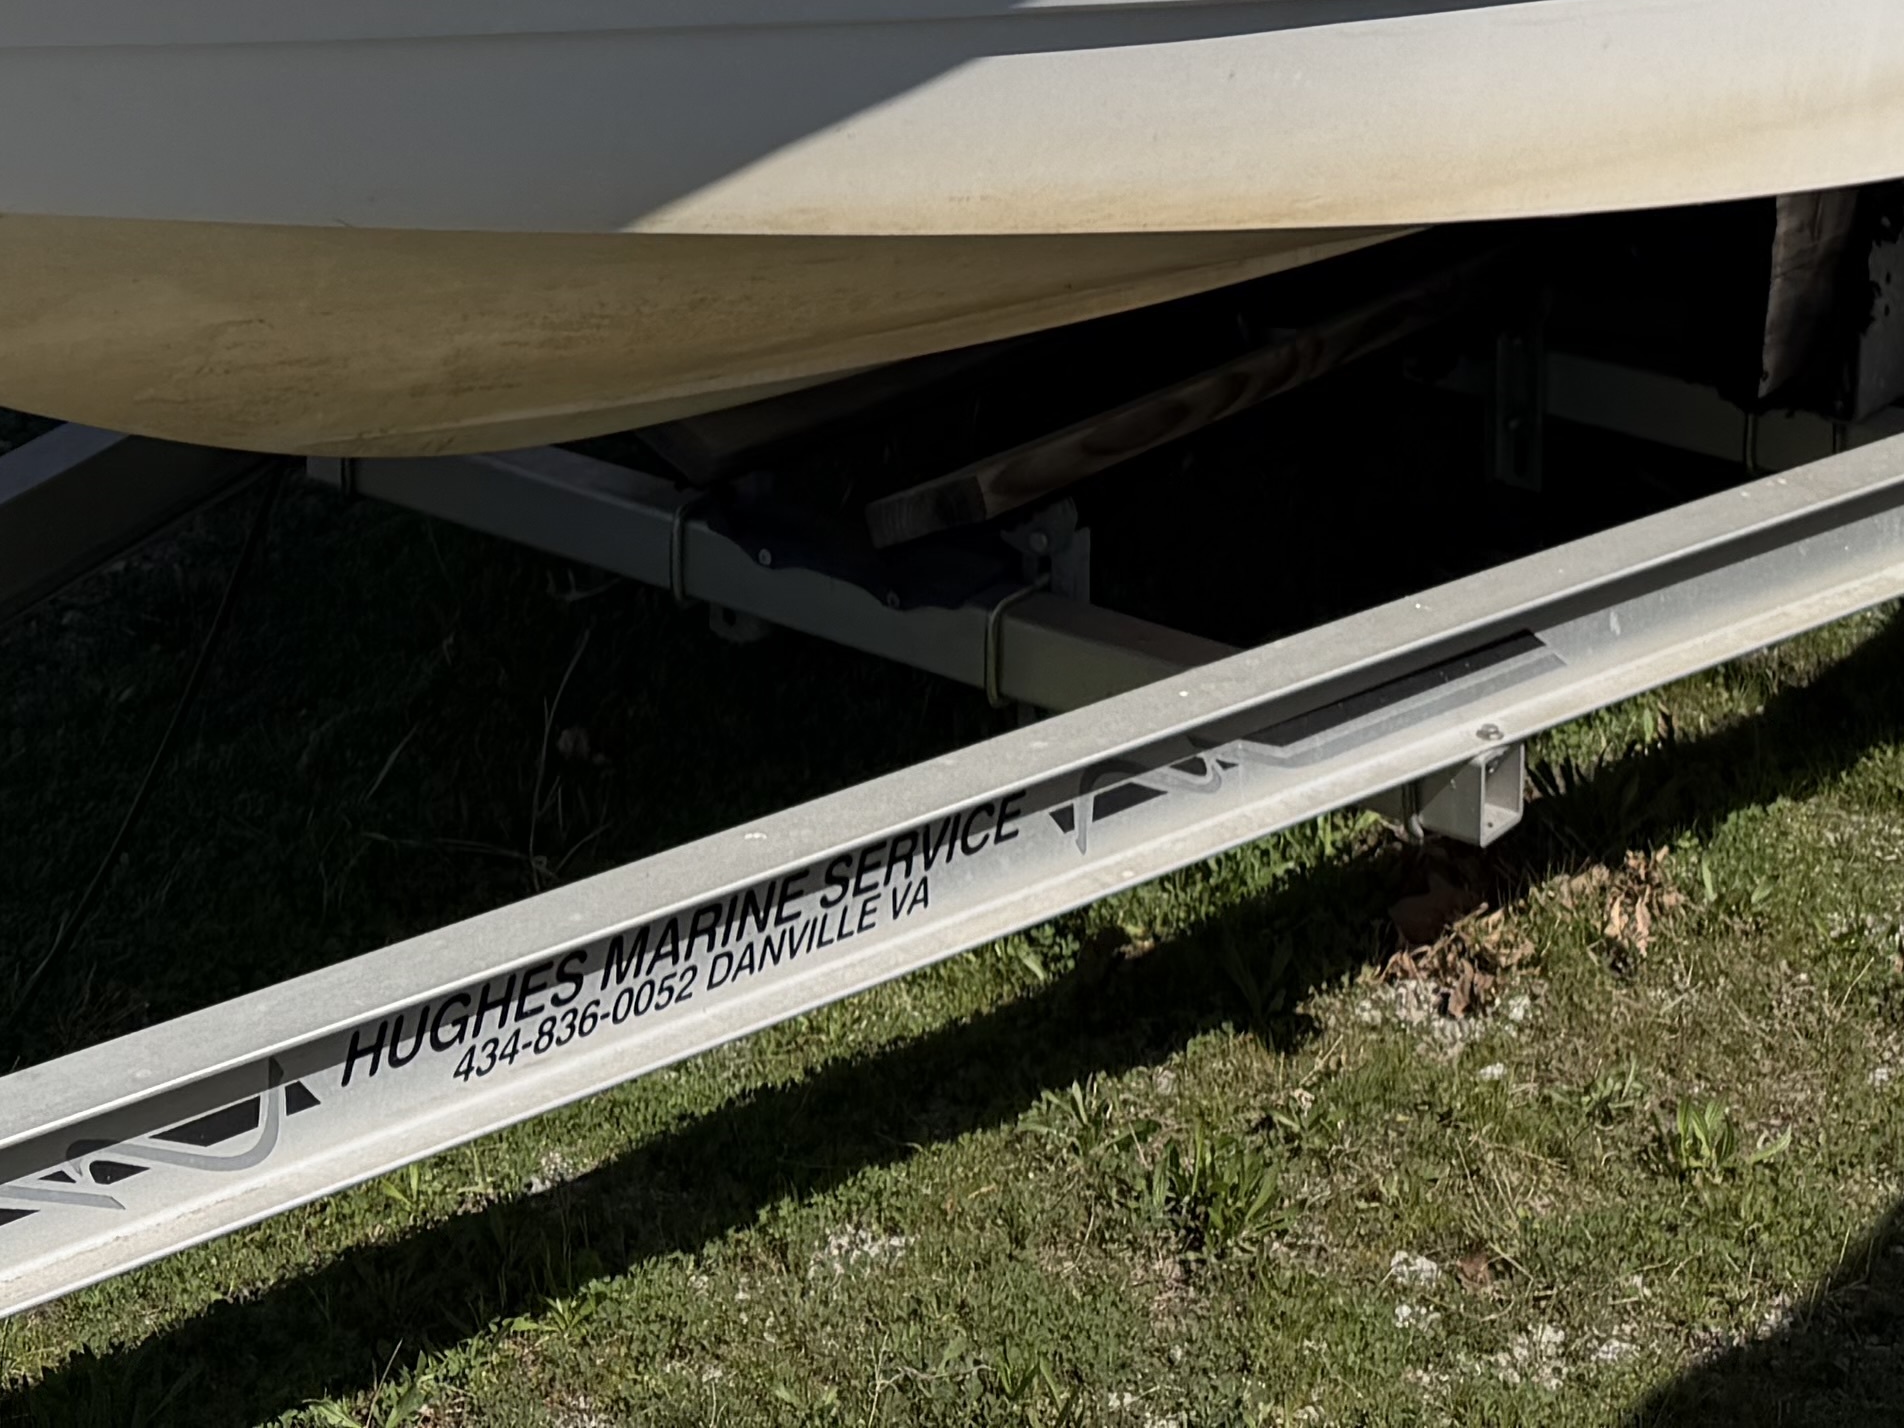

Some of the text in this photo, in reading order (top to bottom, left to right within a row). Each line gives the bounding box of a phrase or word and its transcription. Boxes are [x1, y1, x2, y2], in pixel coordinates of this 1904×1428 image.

[340, 790, 1027, 1087] HUGHES MARINE SERVICE
[453, 876, 930, 1083] 434-836-0052 DANVILLE VA
